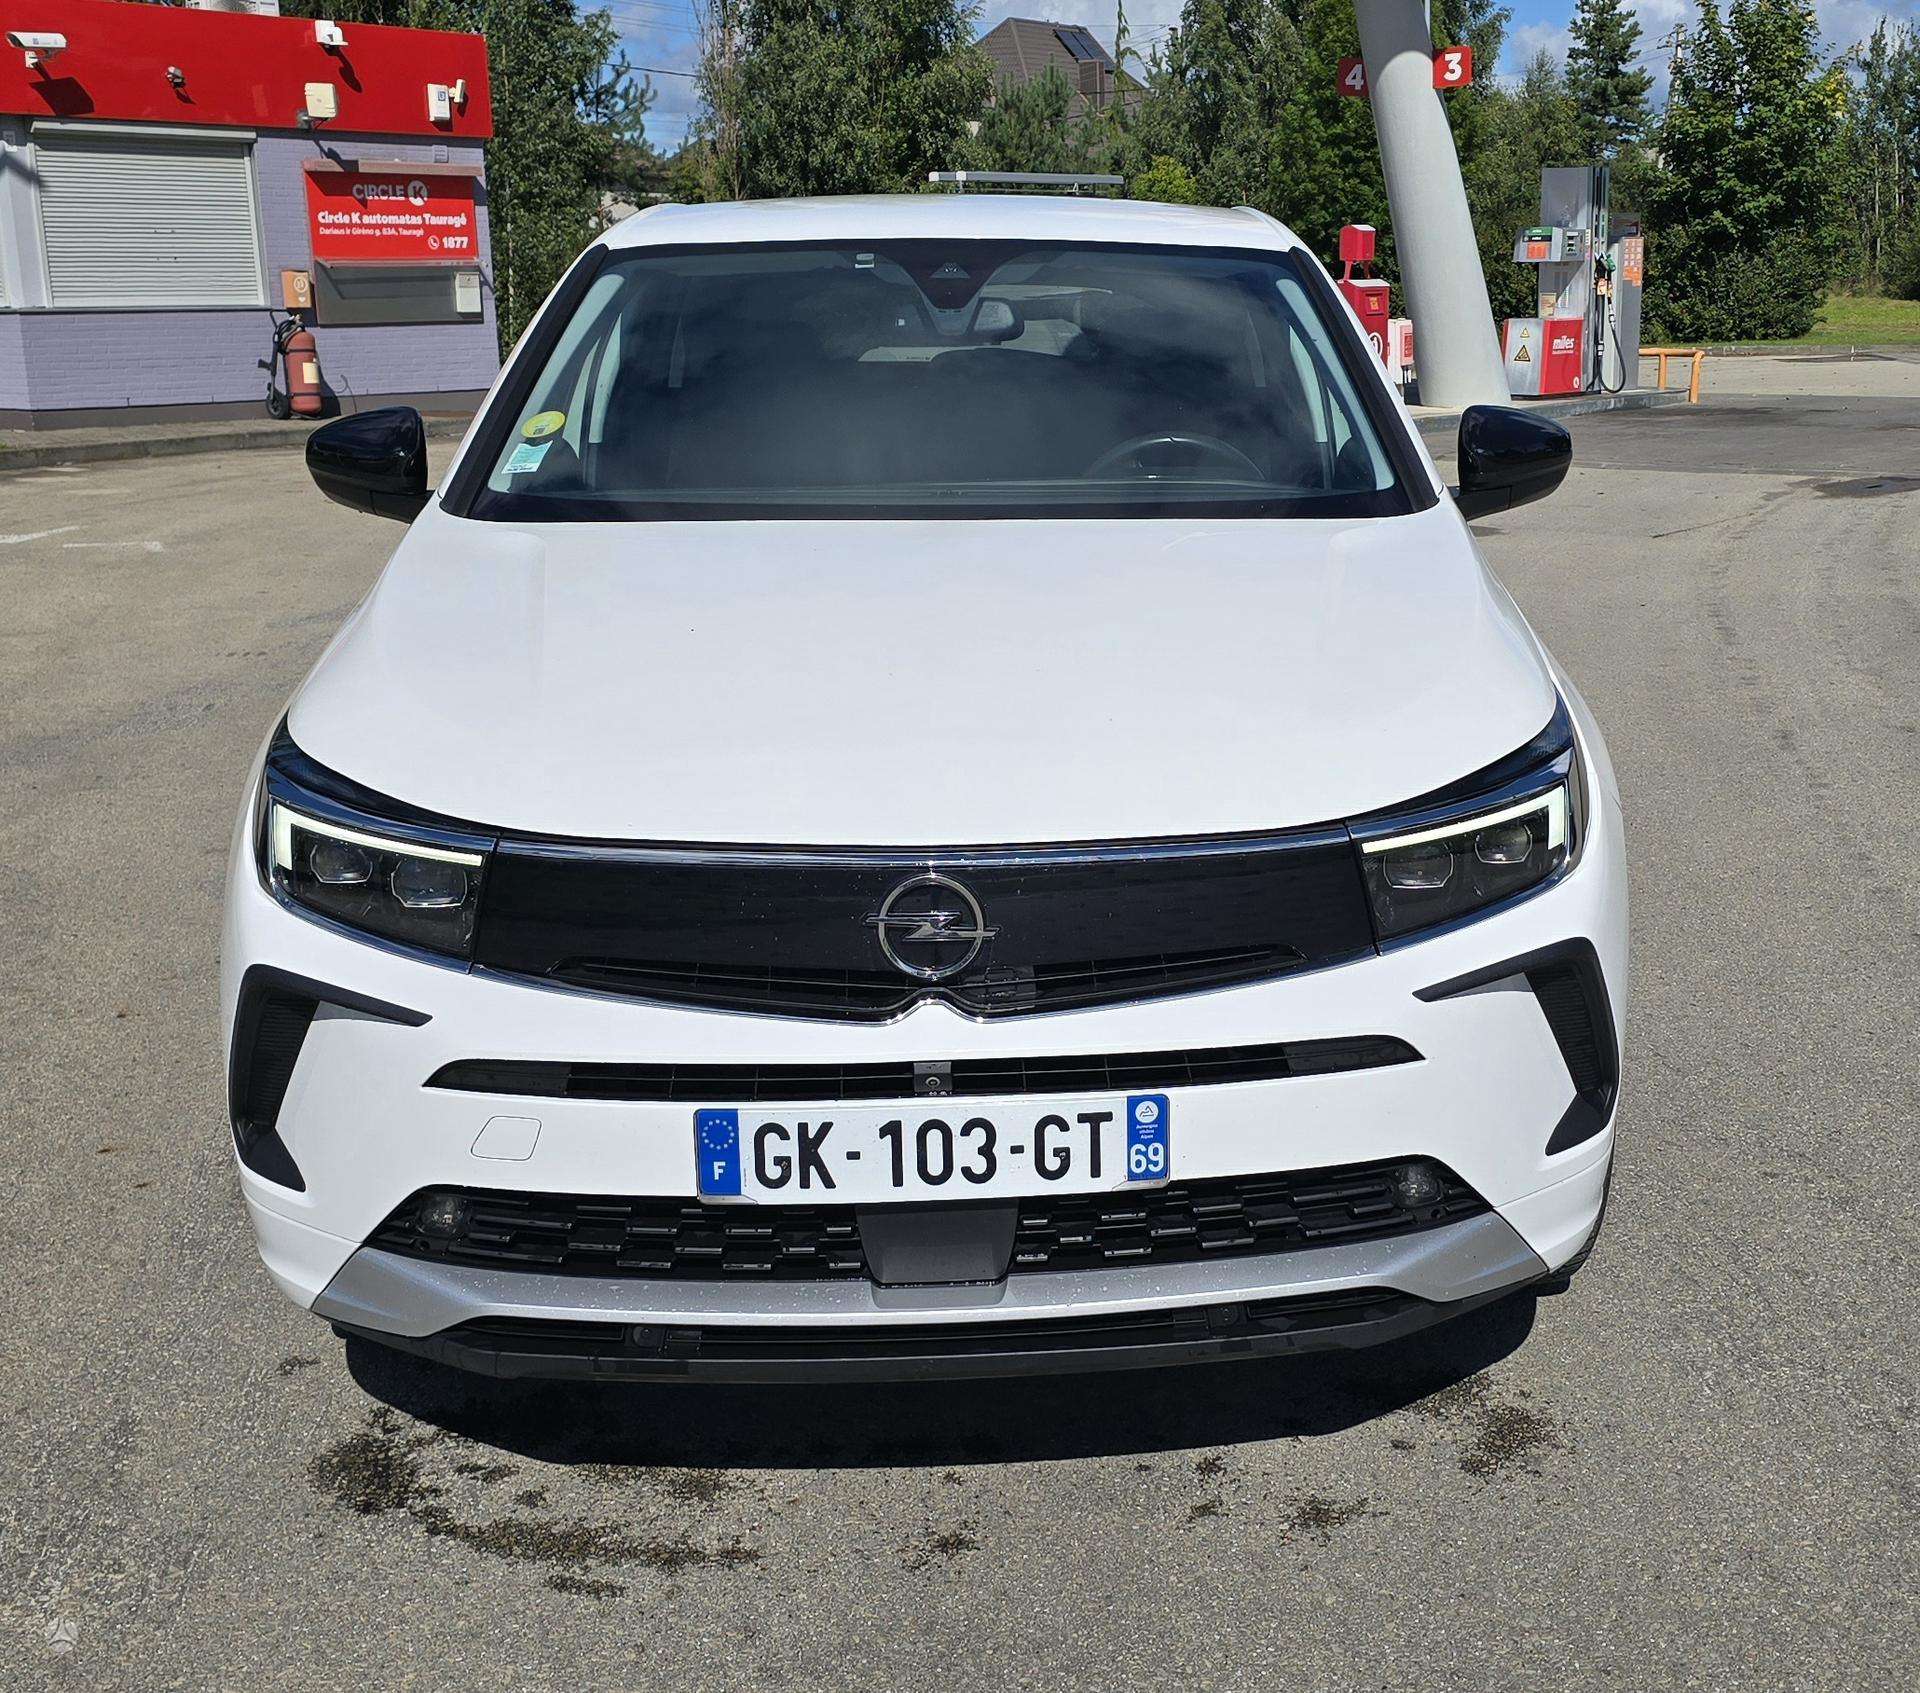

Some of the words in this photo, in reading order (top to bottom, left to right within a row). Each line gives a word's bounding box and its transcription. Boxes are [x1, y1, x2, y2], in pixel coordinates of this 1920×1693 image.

[1344, 63, 1365, 91] 4
[1443, 53, 1463, 81] 3
[352, 184, 406, 200] CIRCLE
[317, 211, 350, 224] Circle
[351, 212, 361, 224] K
[362, 213, 422, 225] automatas
[423, 213, 467, 228] Tauragė
[442, 236, 468, 249] 1877
[1552, 335, 1575, 350] miles
[753, 1111, 1114, 1190] GK-103-GT
[1130, 1142, 1164, 1174] 69
[713, 1161, 726, 1181] F
